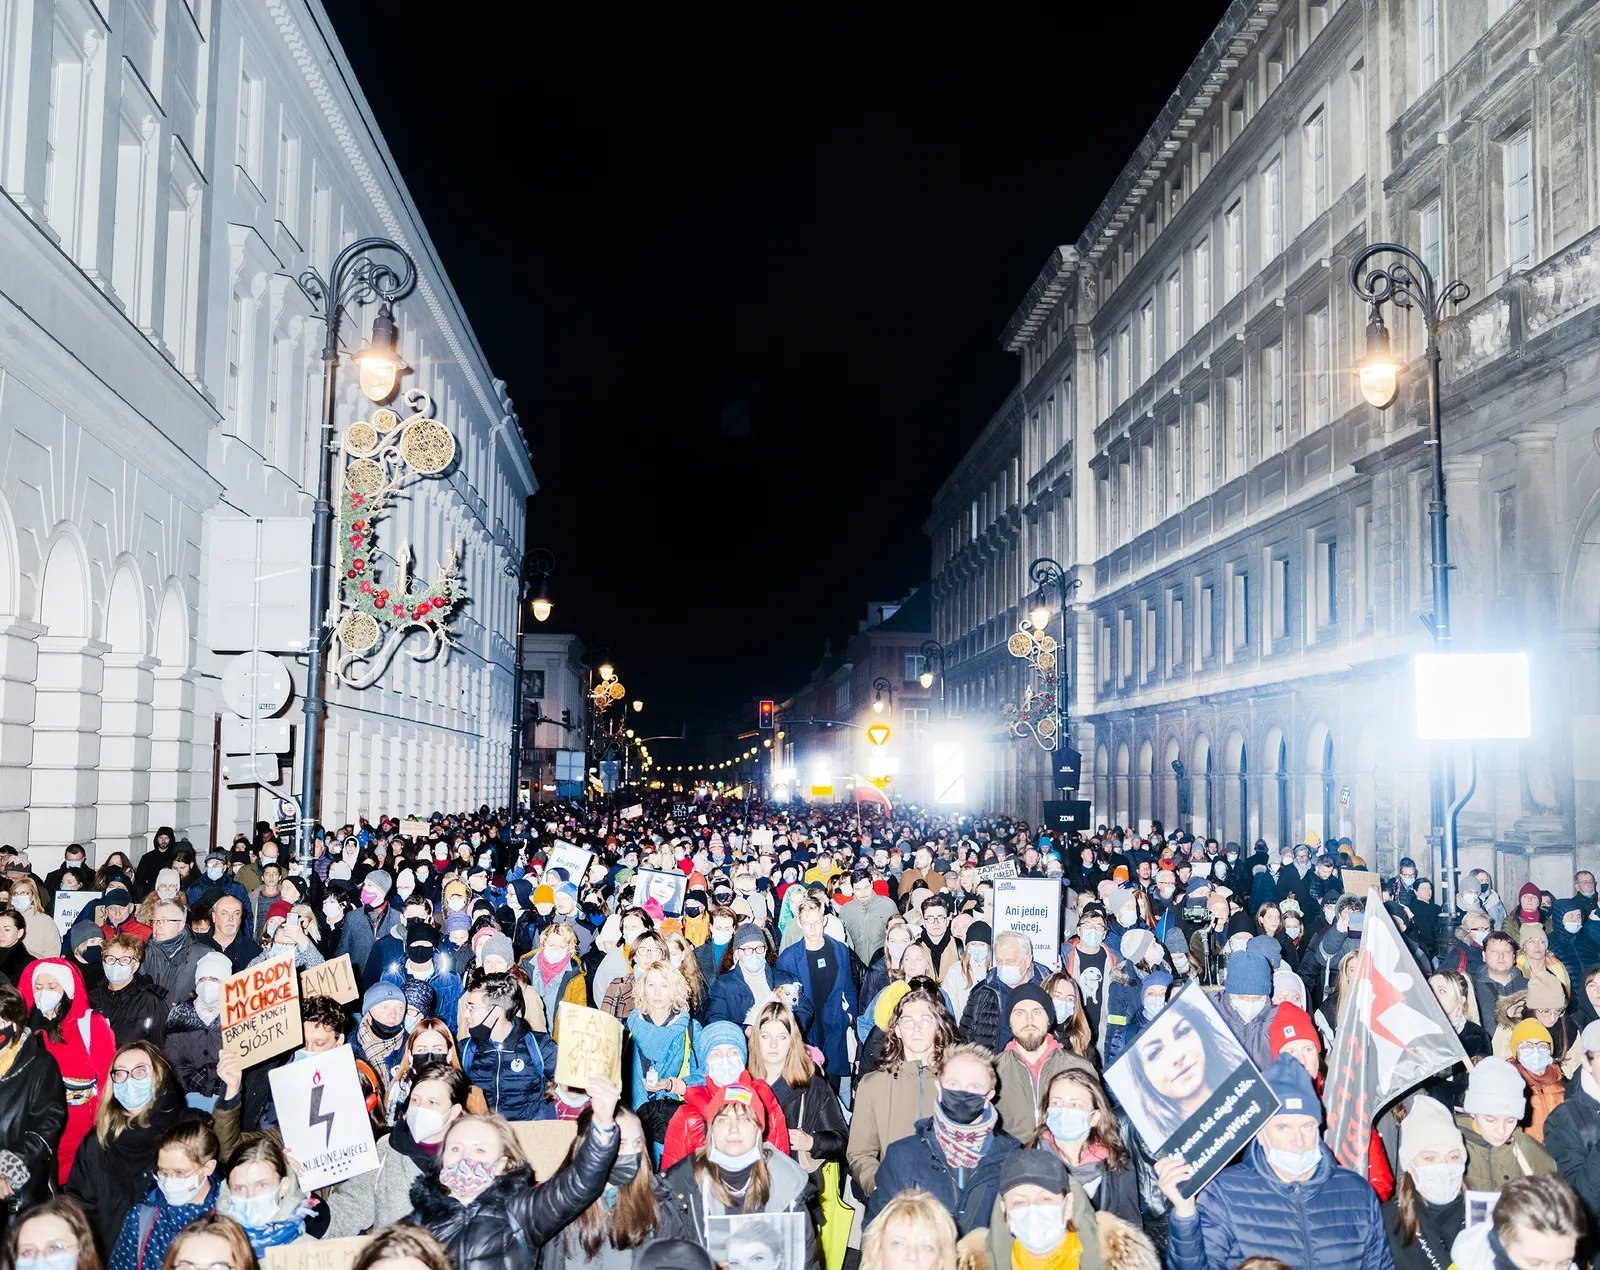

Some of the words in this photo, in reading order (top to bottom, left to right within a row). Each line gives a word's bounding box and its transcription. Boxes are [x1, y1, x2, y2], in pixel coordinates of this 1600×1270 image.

[1005, 905, 1020, 916] Ani
[1021, 905, 1049, 919] jednej
[1010, 921, 1042, 934] więcej.
[225, 976, 250, 1003] MY
[253, 958, 293, 991] BODY
[224, 1017, 257, 1043] BRONIĘ
[260, 1005, 287, 1024] MOICH
[226, 997, 250, 1025] MY
[1181, 1130, 1204, 1154] serce
[1199, 1116, 1217, 1133] też
[1213, 1095, 1239, 1121] ciągle
